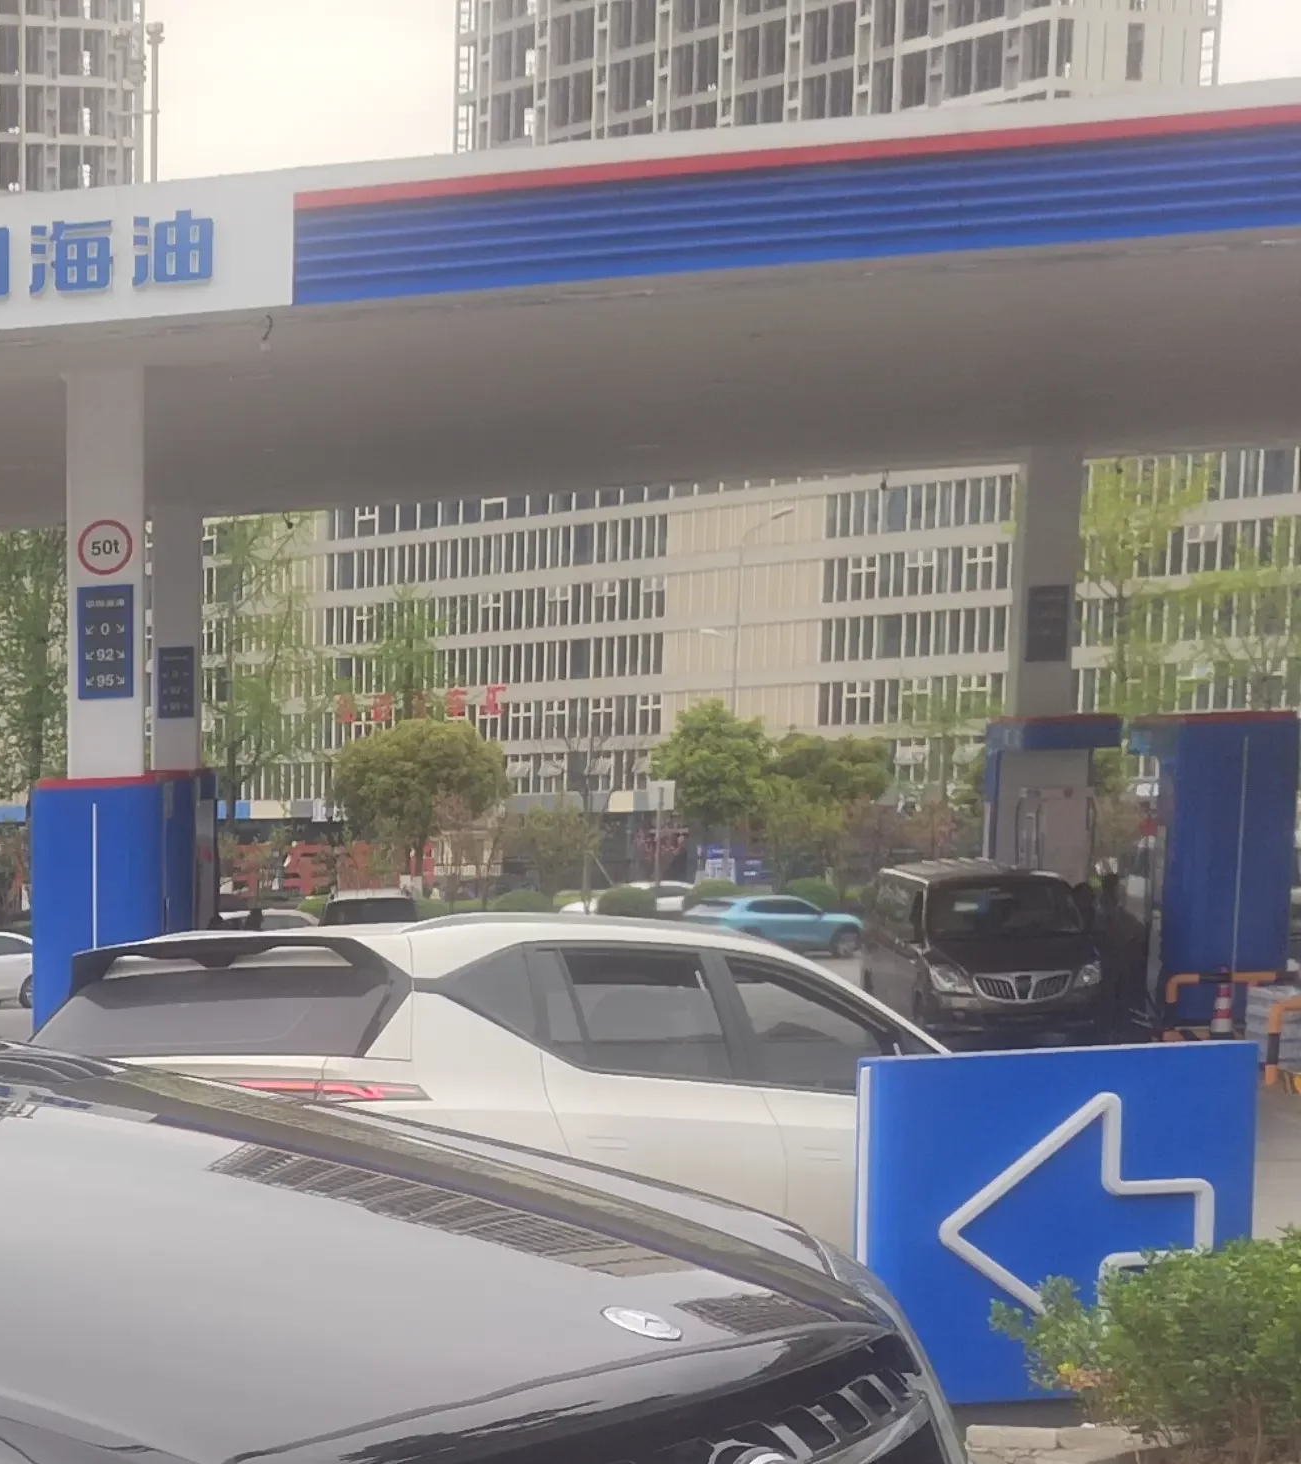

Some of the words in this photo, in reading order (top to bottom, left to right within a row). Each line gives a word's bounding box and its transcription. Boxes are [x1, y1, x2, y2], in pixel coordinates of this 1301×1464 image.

[91, 539, 120, 556] 50t
[100, 622, 110, 636] 0
[96, 648, 115, 662] 92
[96, 673, 115, 687] 95
